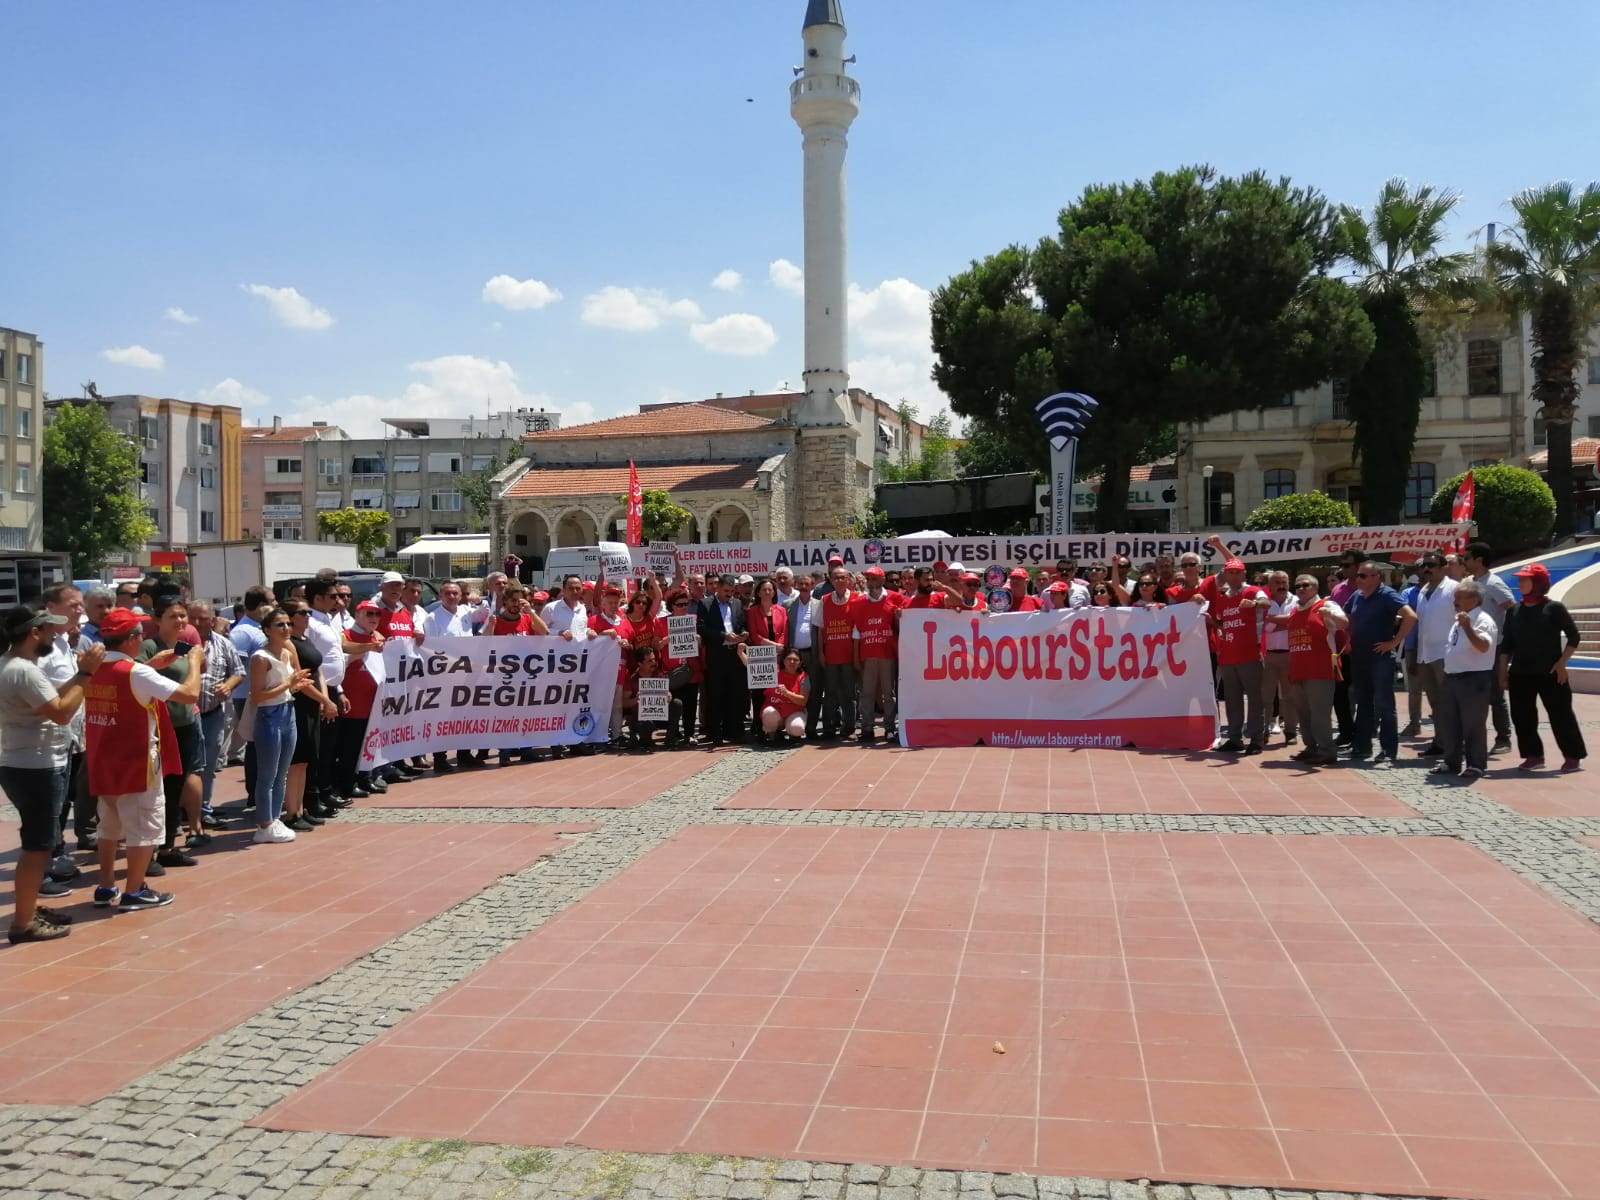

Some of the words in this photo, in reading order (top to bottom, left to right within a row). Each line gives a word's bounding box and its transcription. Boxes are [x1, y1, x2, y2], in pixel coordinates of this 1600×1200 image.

[1320, 531, 1383, 542] ATILAN
[697, 547, 725, 560] DEĞİL
[727, 546, 751, 559] KRİZİ
[774, 543, 857, 567] ALİAĞA
[1005, 537, 1106, 565] İŞÇİLERİ
[1115, 536, 1217, 562] DİRENİŞ
[689, 563, 731, 575] FATURAYI
[922, 614, 1188, 682] LabourStart
[486, 649, 588, 680] İŞÇİSİ
[450, 680, 590, 708] DEĞİLDİR
[391, 725, 415, 745] GENEL
[422, 720, 432, 743] İŞ
[436, 716, 490, 738] SENDİKASI
[491, 716, 519, 735] İZMİR
[521, 713, 566, 737] ŞUBELERİ
